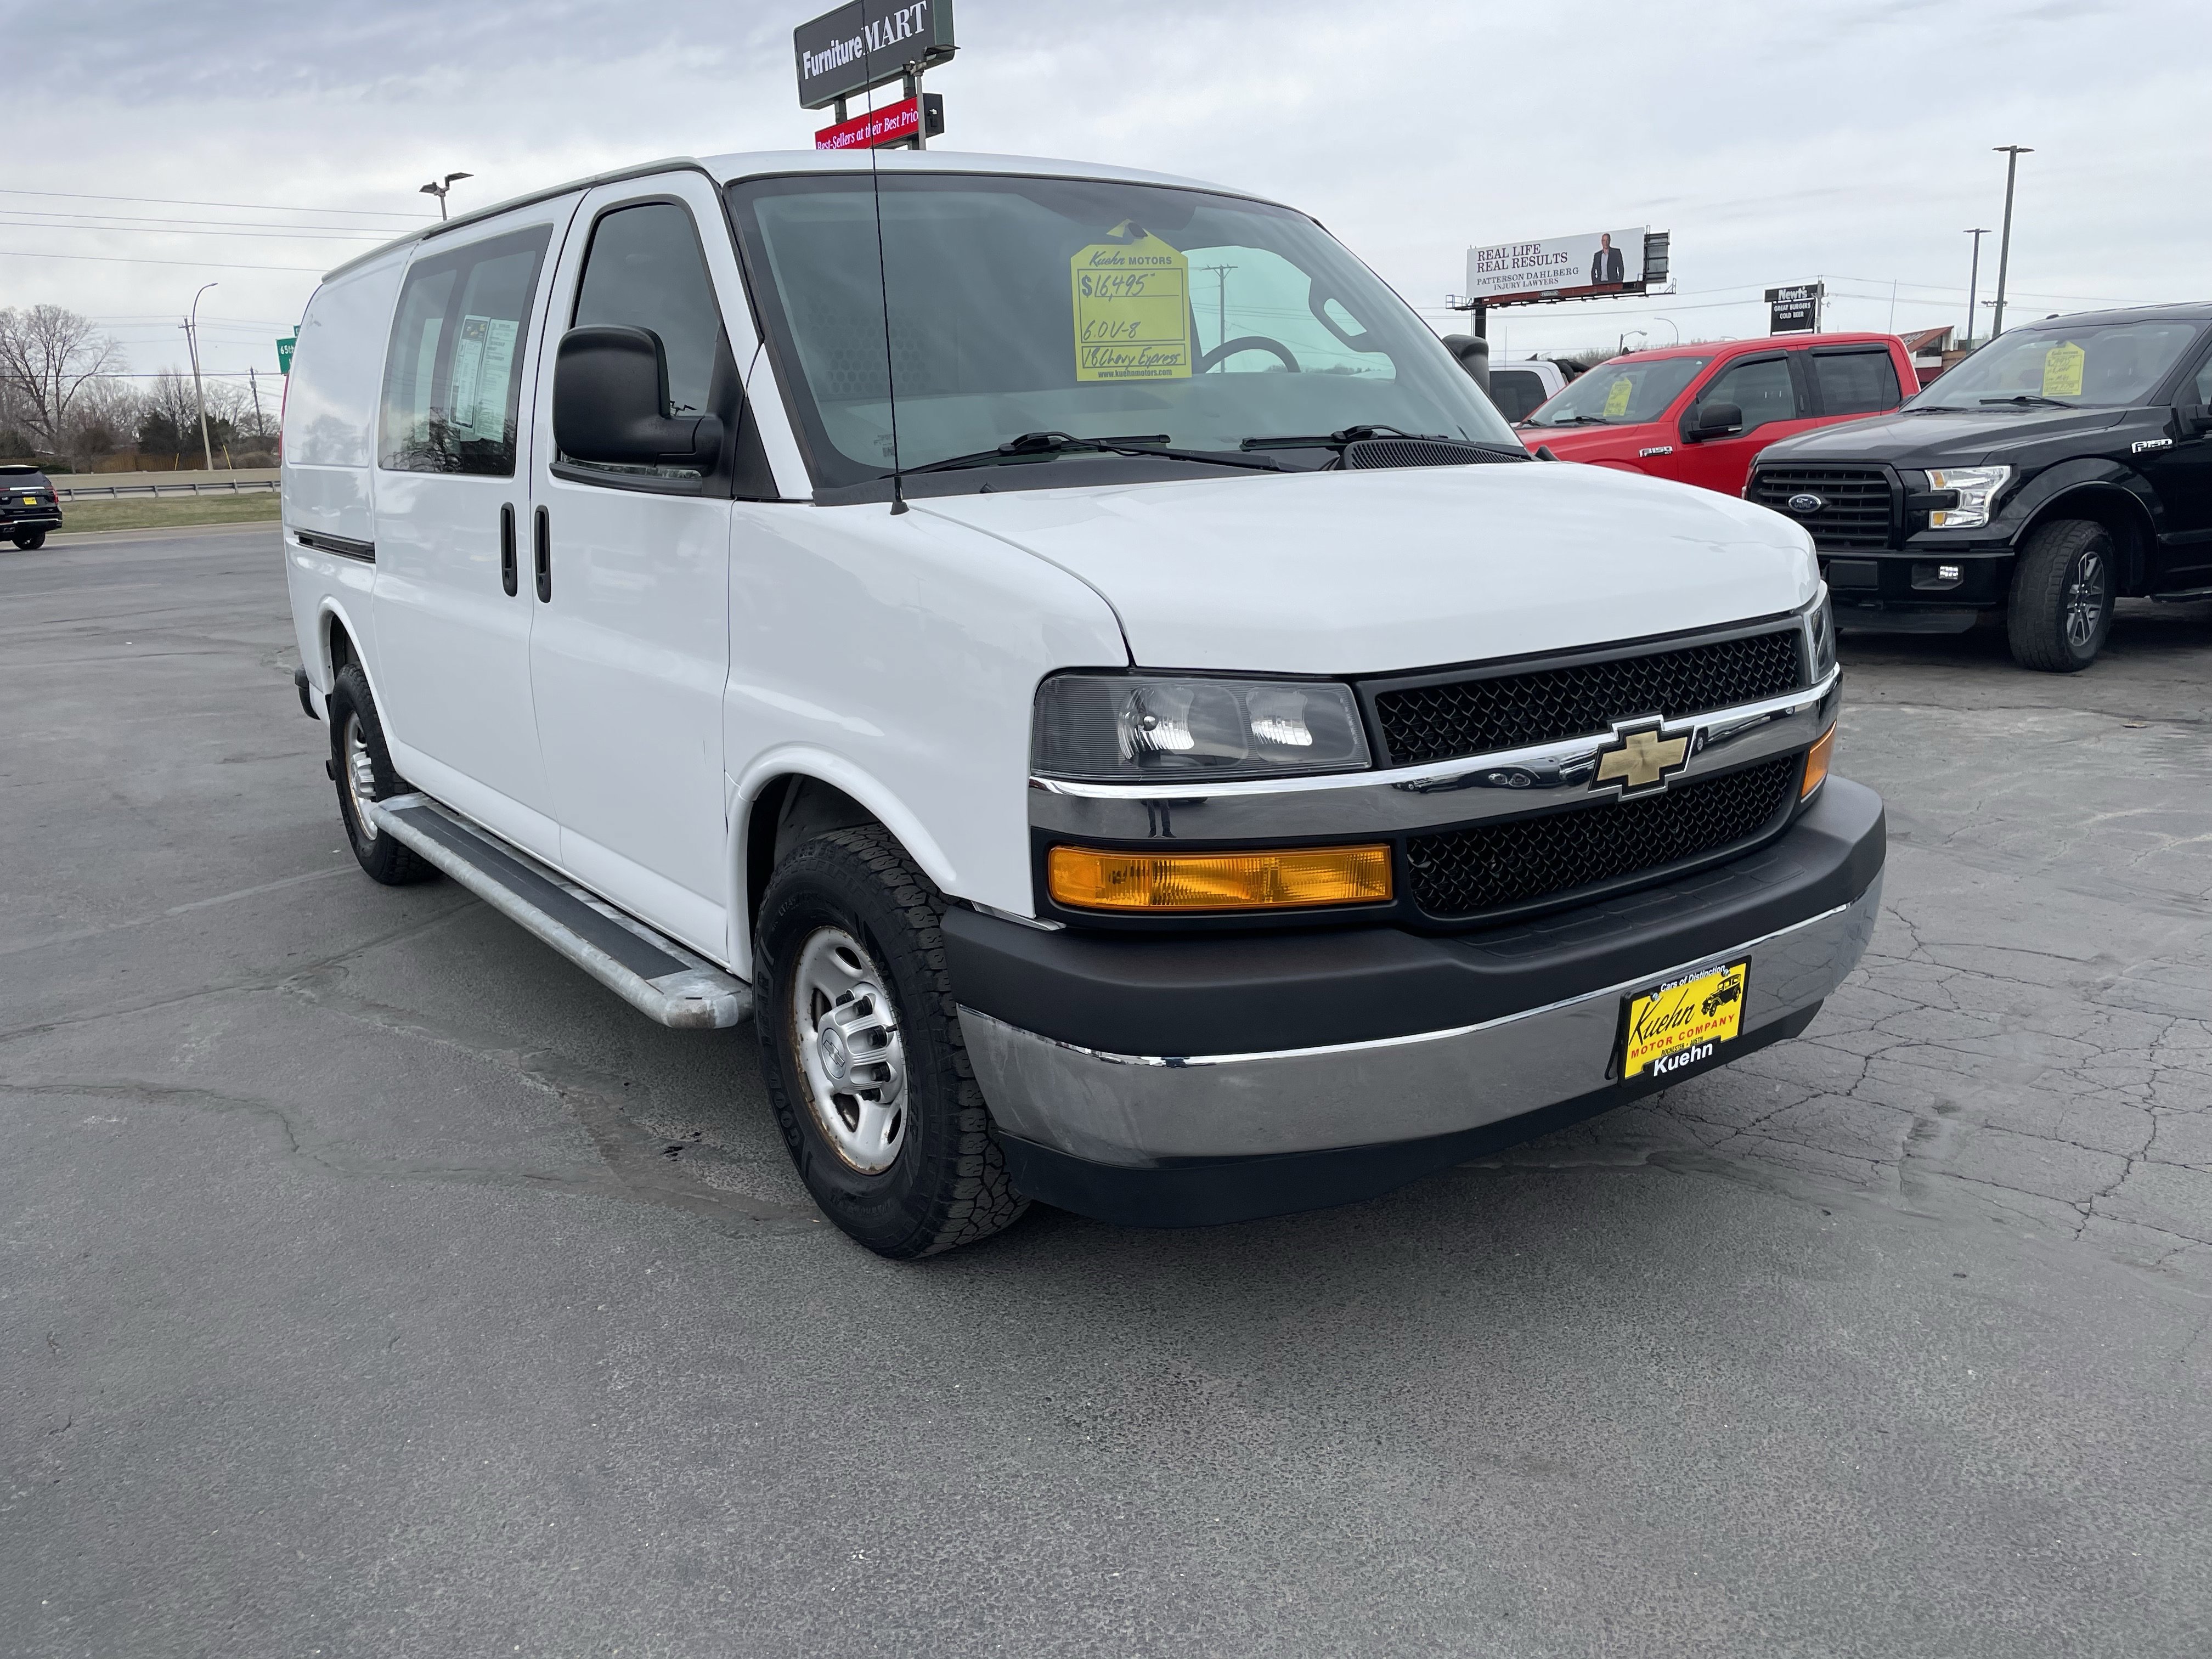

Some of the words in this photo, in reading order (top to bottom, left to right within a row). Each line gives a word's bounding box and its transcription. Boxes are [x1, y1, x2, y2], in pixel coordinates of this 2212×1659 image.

[856, 127, 864, 141] at
[865, 120, 882, 137] their
[884, 115, 900, 132] Best
[1089, 251, 1125, 267] Kuehn
[1128, 256, 1172, 265] MOTORS
[1477, 247, 1509, 262] REAL
[1512, 243, 1541, 257] LIFE
[1477, 259, 1509, 273] REAL
[1511, 252, 1568, 269] RESULTS
[1477, 273, 1525, 285] PATTERSON
[1526, 267, 1579, 280] DAHLBERG
[1494, 281, 1521, 291] INJURY
[1522, 278, 1559, 287] LAWYERS
[1778, 286, 1808, 301] Newt's
[1790, 302, 1811, 310] BURGERS
[1138, 347, 1181, 368] Express
[1098, 369, 1172, 378] www.kuehnmotors.com
[1660, 983, 1678, 992] Cars
[1679, 975, 1688, 986] of
[1688, 965, 1725, 984] Distinction
[1629, 988, 1695, 1046] Kuehn
[1630, 1036, 1673, 1059] MOTOR
[1678, 1013, 1735, 1041] COMPANY
[1653, 1043, 1713, 1077] Kuehn
